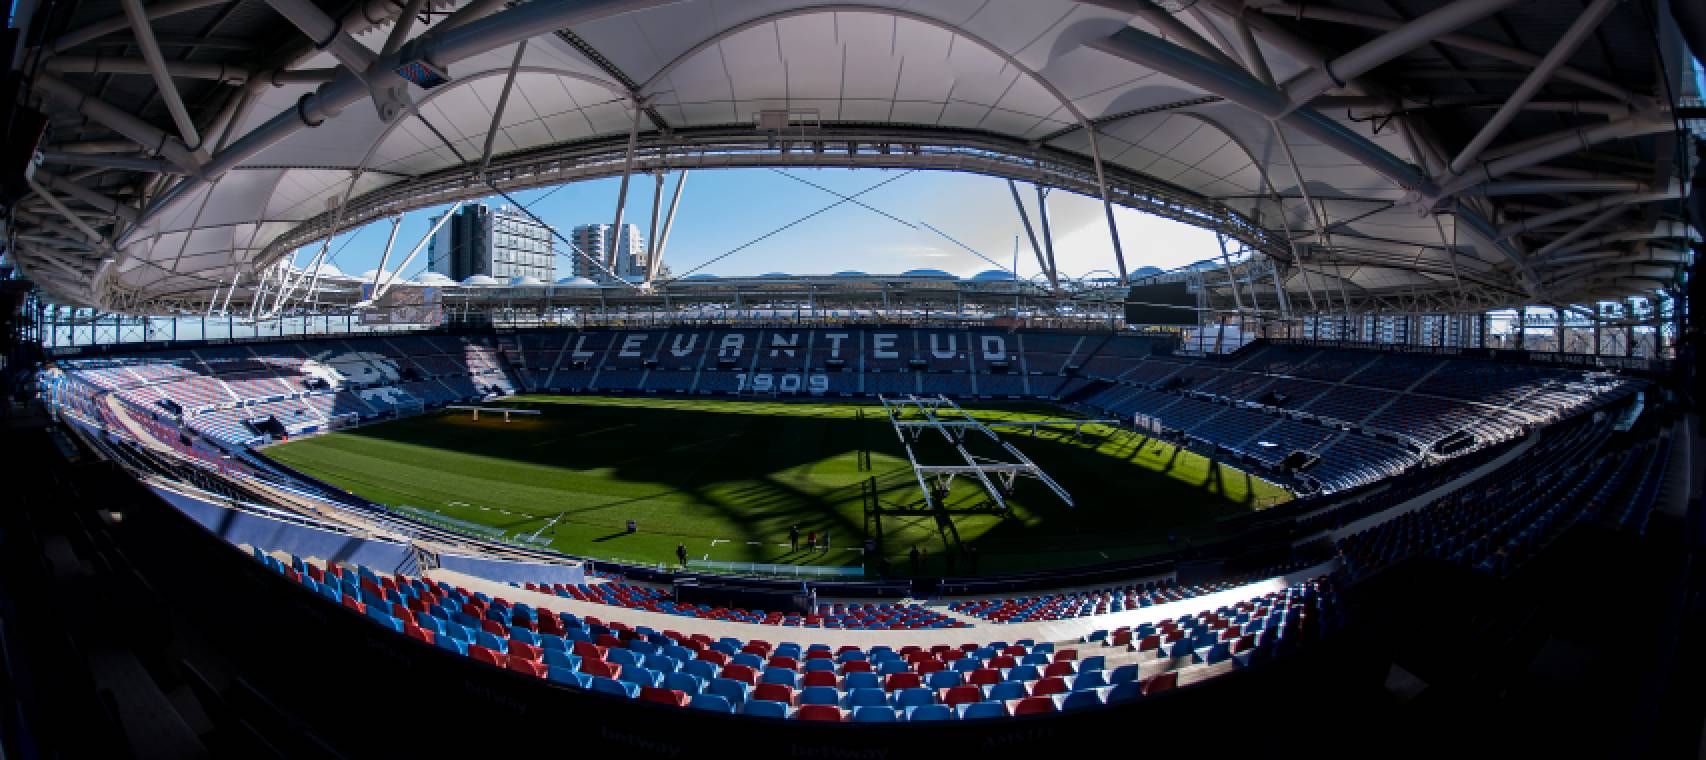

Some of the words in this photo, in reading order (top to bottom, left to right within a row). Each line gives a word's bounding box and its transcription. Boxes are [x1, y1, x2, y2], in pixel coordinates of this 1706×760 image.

[571, 333, 898, 359] LEVANTE
[929, 333, 1017, 361] U.D.
[736, 373, 829, 392] 1909
